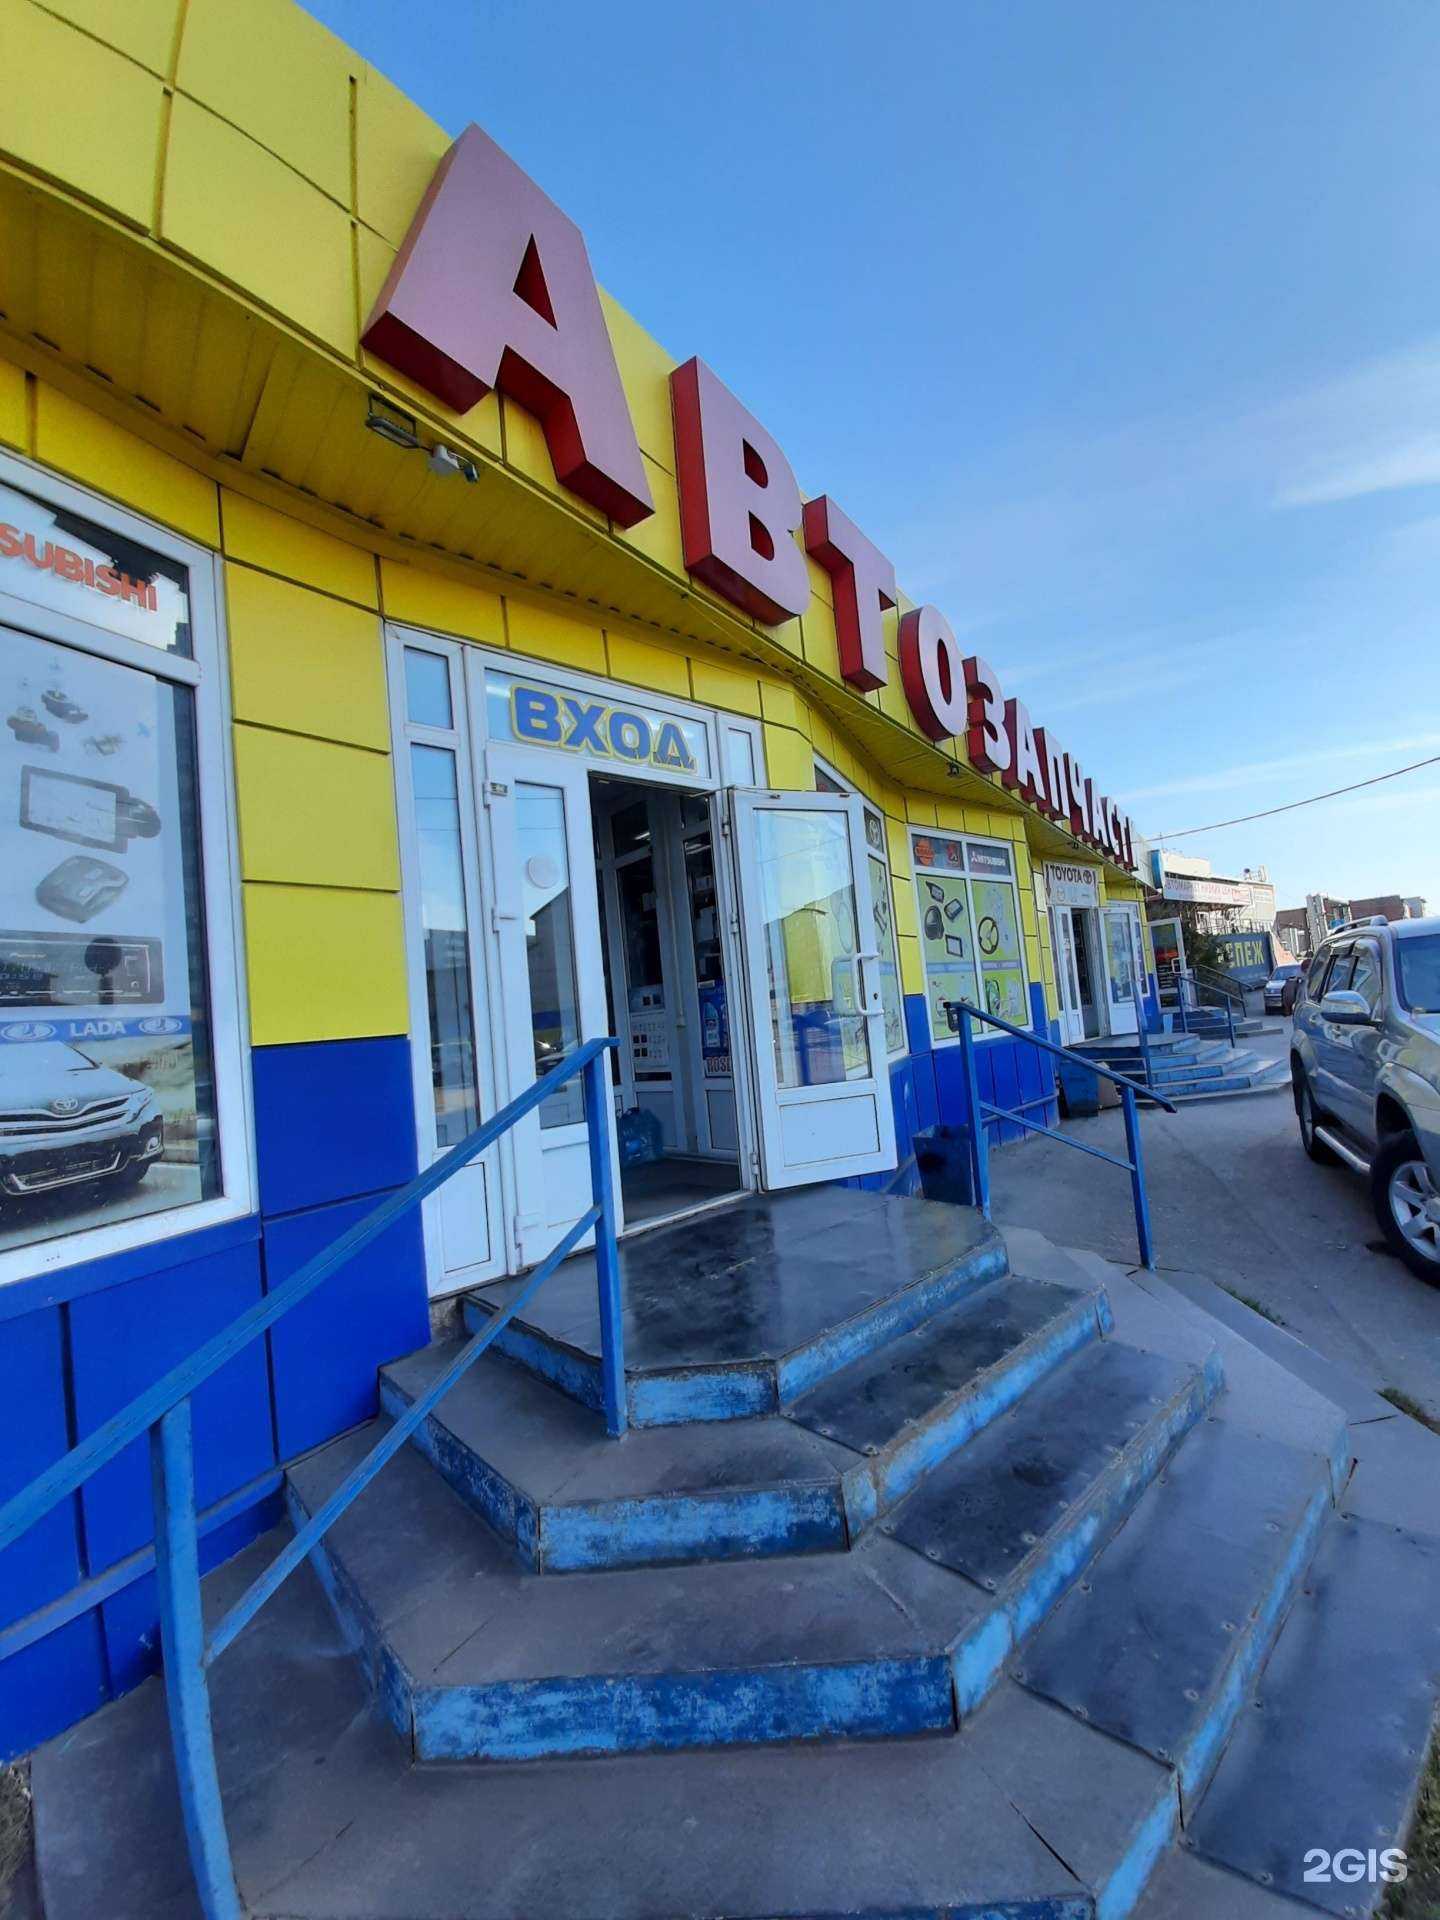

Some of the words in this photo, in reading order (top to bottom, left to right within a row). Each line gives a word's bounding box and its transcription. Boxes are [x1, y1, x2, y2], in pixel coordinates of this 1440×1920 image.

[512, 685, 696, 772] ВХОД
[1050, 865, 1083, 884] TOYOTA
[69, 1020, 127, 1037] LADA
